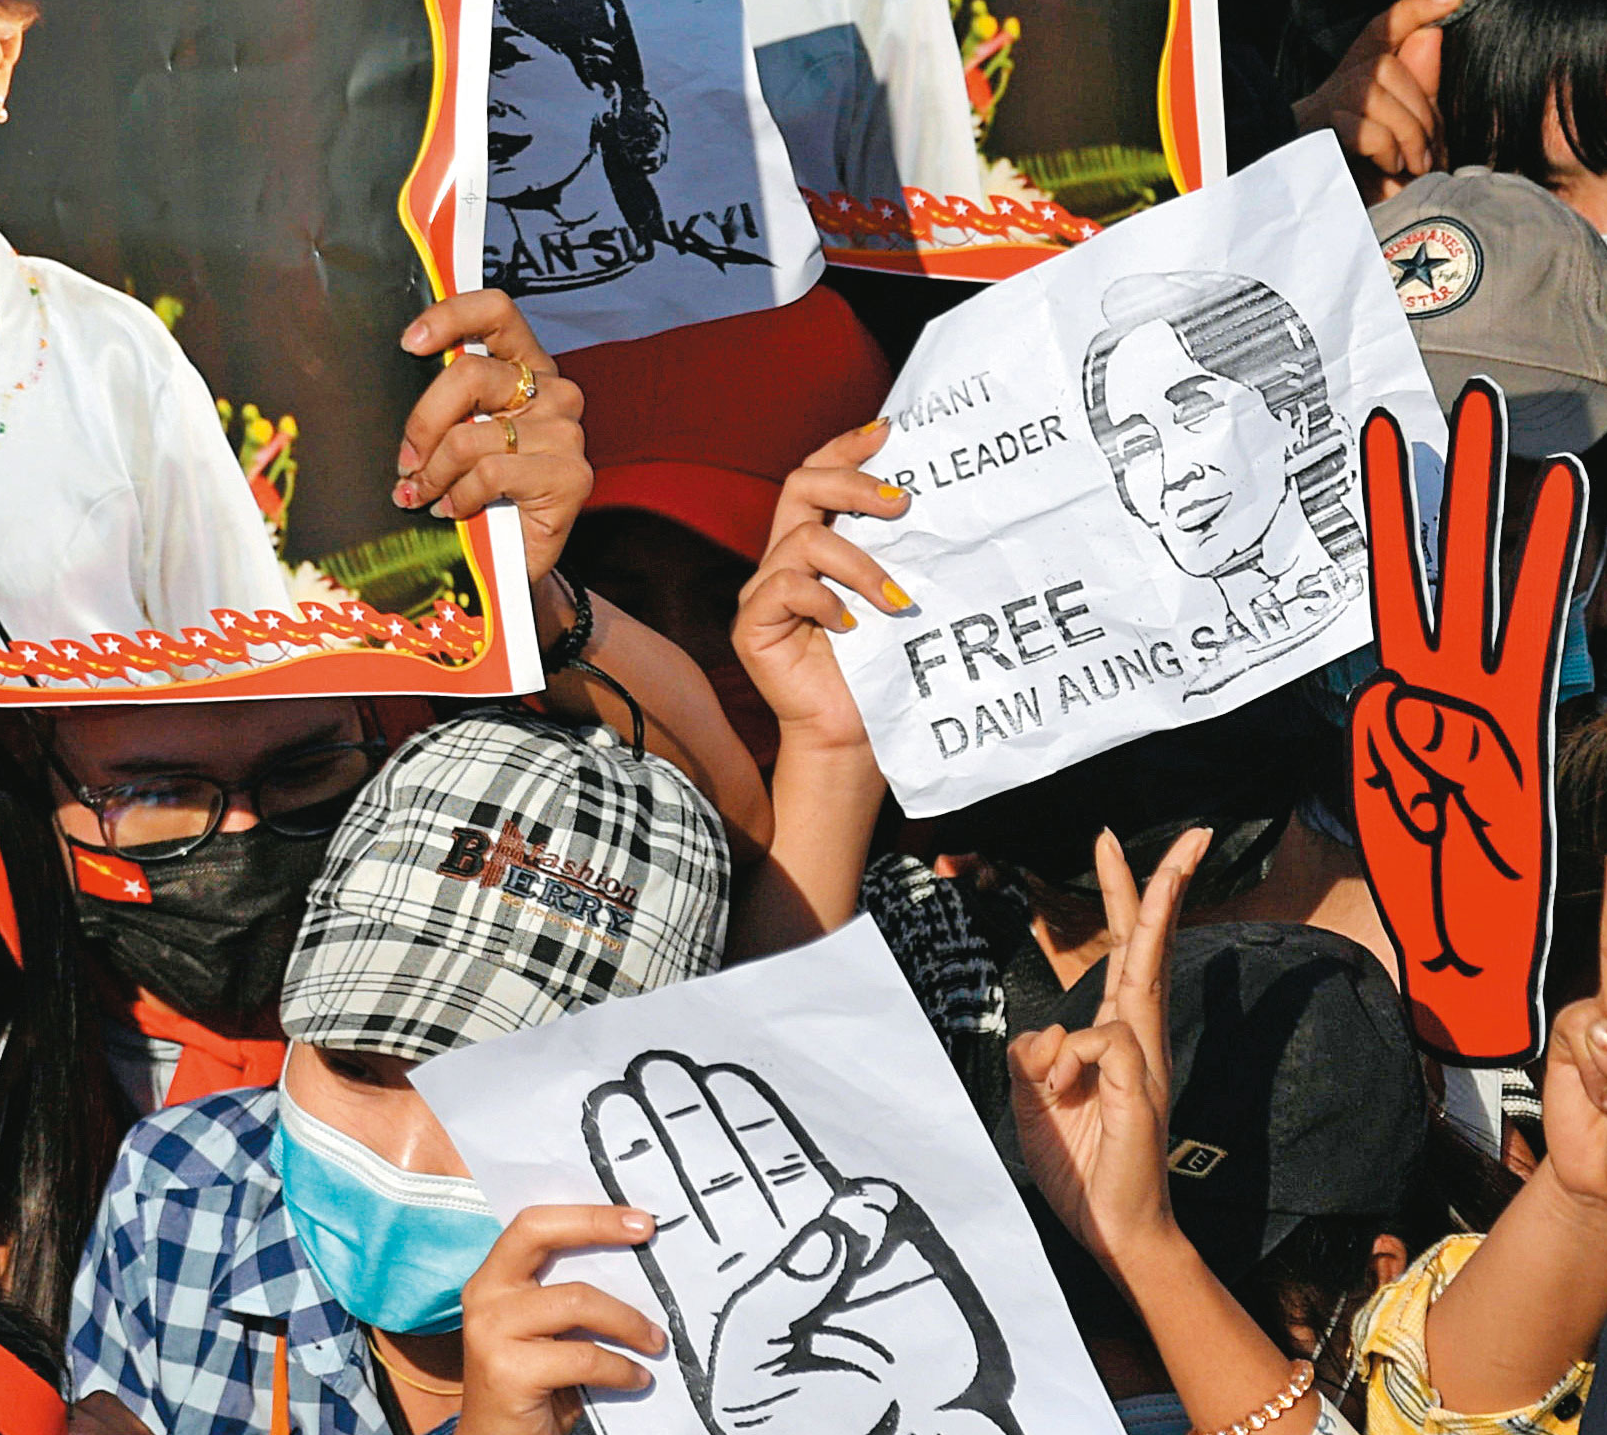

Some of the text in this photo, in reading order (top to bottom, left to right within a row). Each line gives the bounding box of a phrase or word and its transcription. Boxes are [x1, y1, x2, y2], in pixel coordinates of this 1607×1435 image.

[668, 202, 760, 261] KYI
[1406, 286, 1453, 307] STAR
[898, 371, 993, 434] WANT
[929, 416, 1067, 490] LEADER
[905, 580, 1106, 701] FREE
[931, 687, 1043, 760] DAW
[1060, 641, 1185, 715] AUNG
[1191, 593, 1290, 662] SAN
[532, 842, 637, 905] fashion
